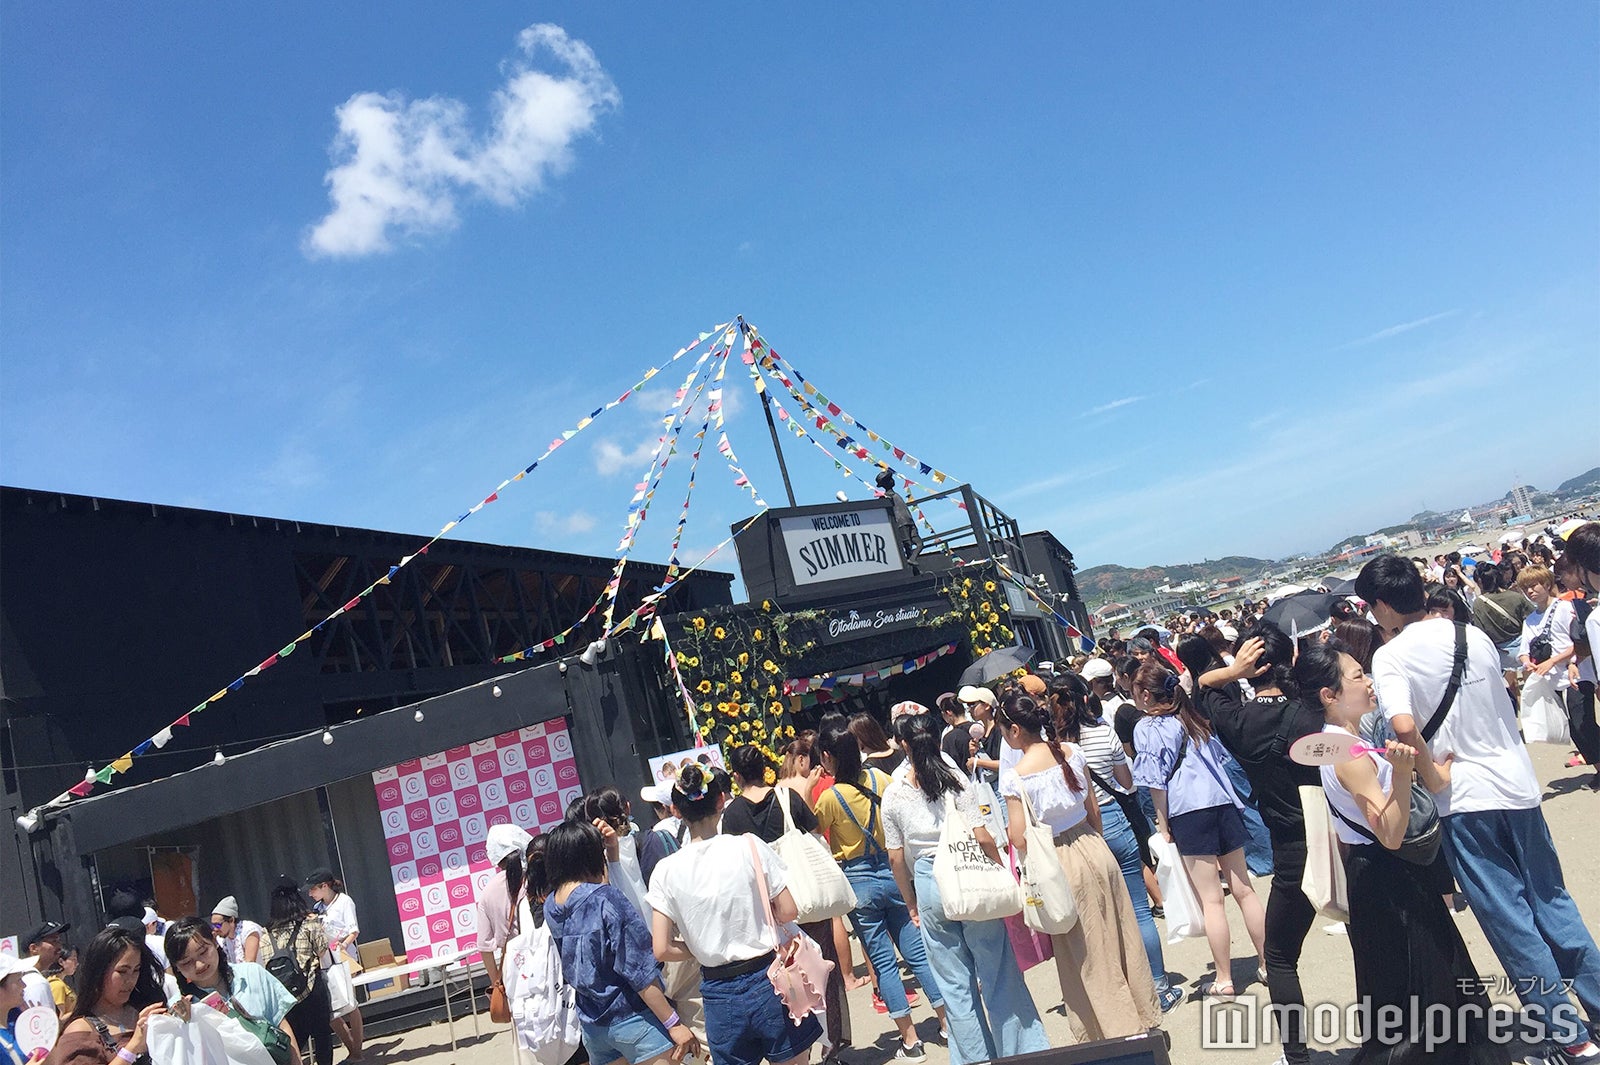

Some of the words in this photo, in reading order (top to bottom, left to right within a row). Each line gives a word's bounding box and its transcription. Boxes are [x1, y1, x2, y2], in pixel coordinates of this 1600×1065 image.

[811, 514, 851, 531] WELCOME
[851, 513, 861, 526] TO
[799, 533, 888, 577] SUMMER
[829, 611, 872, 637] Otodama
[873, 610, 894, 629] Sea
